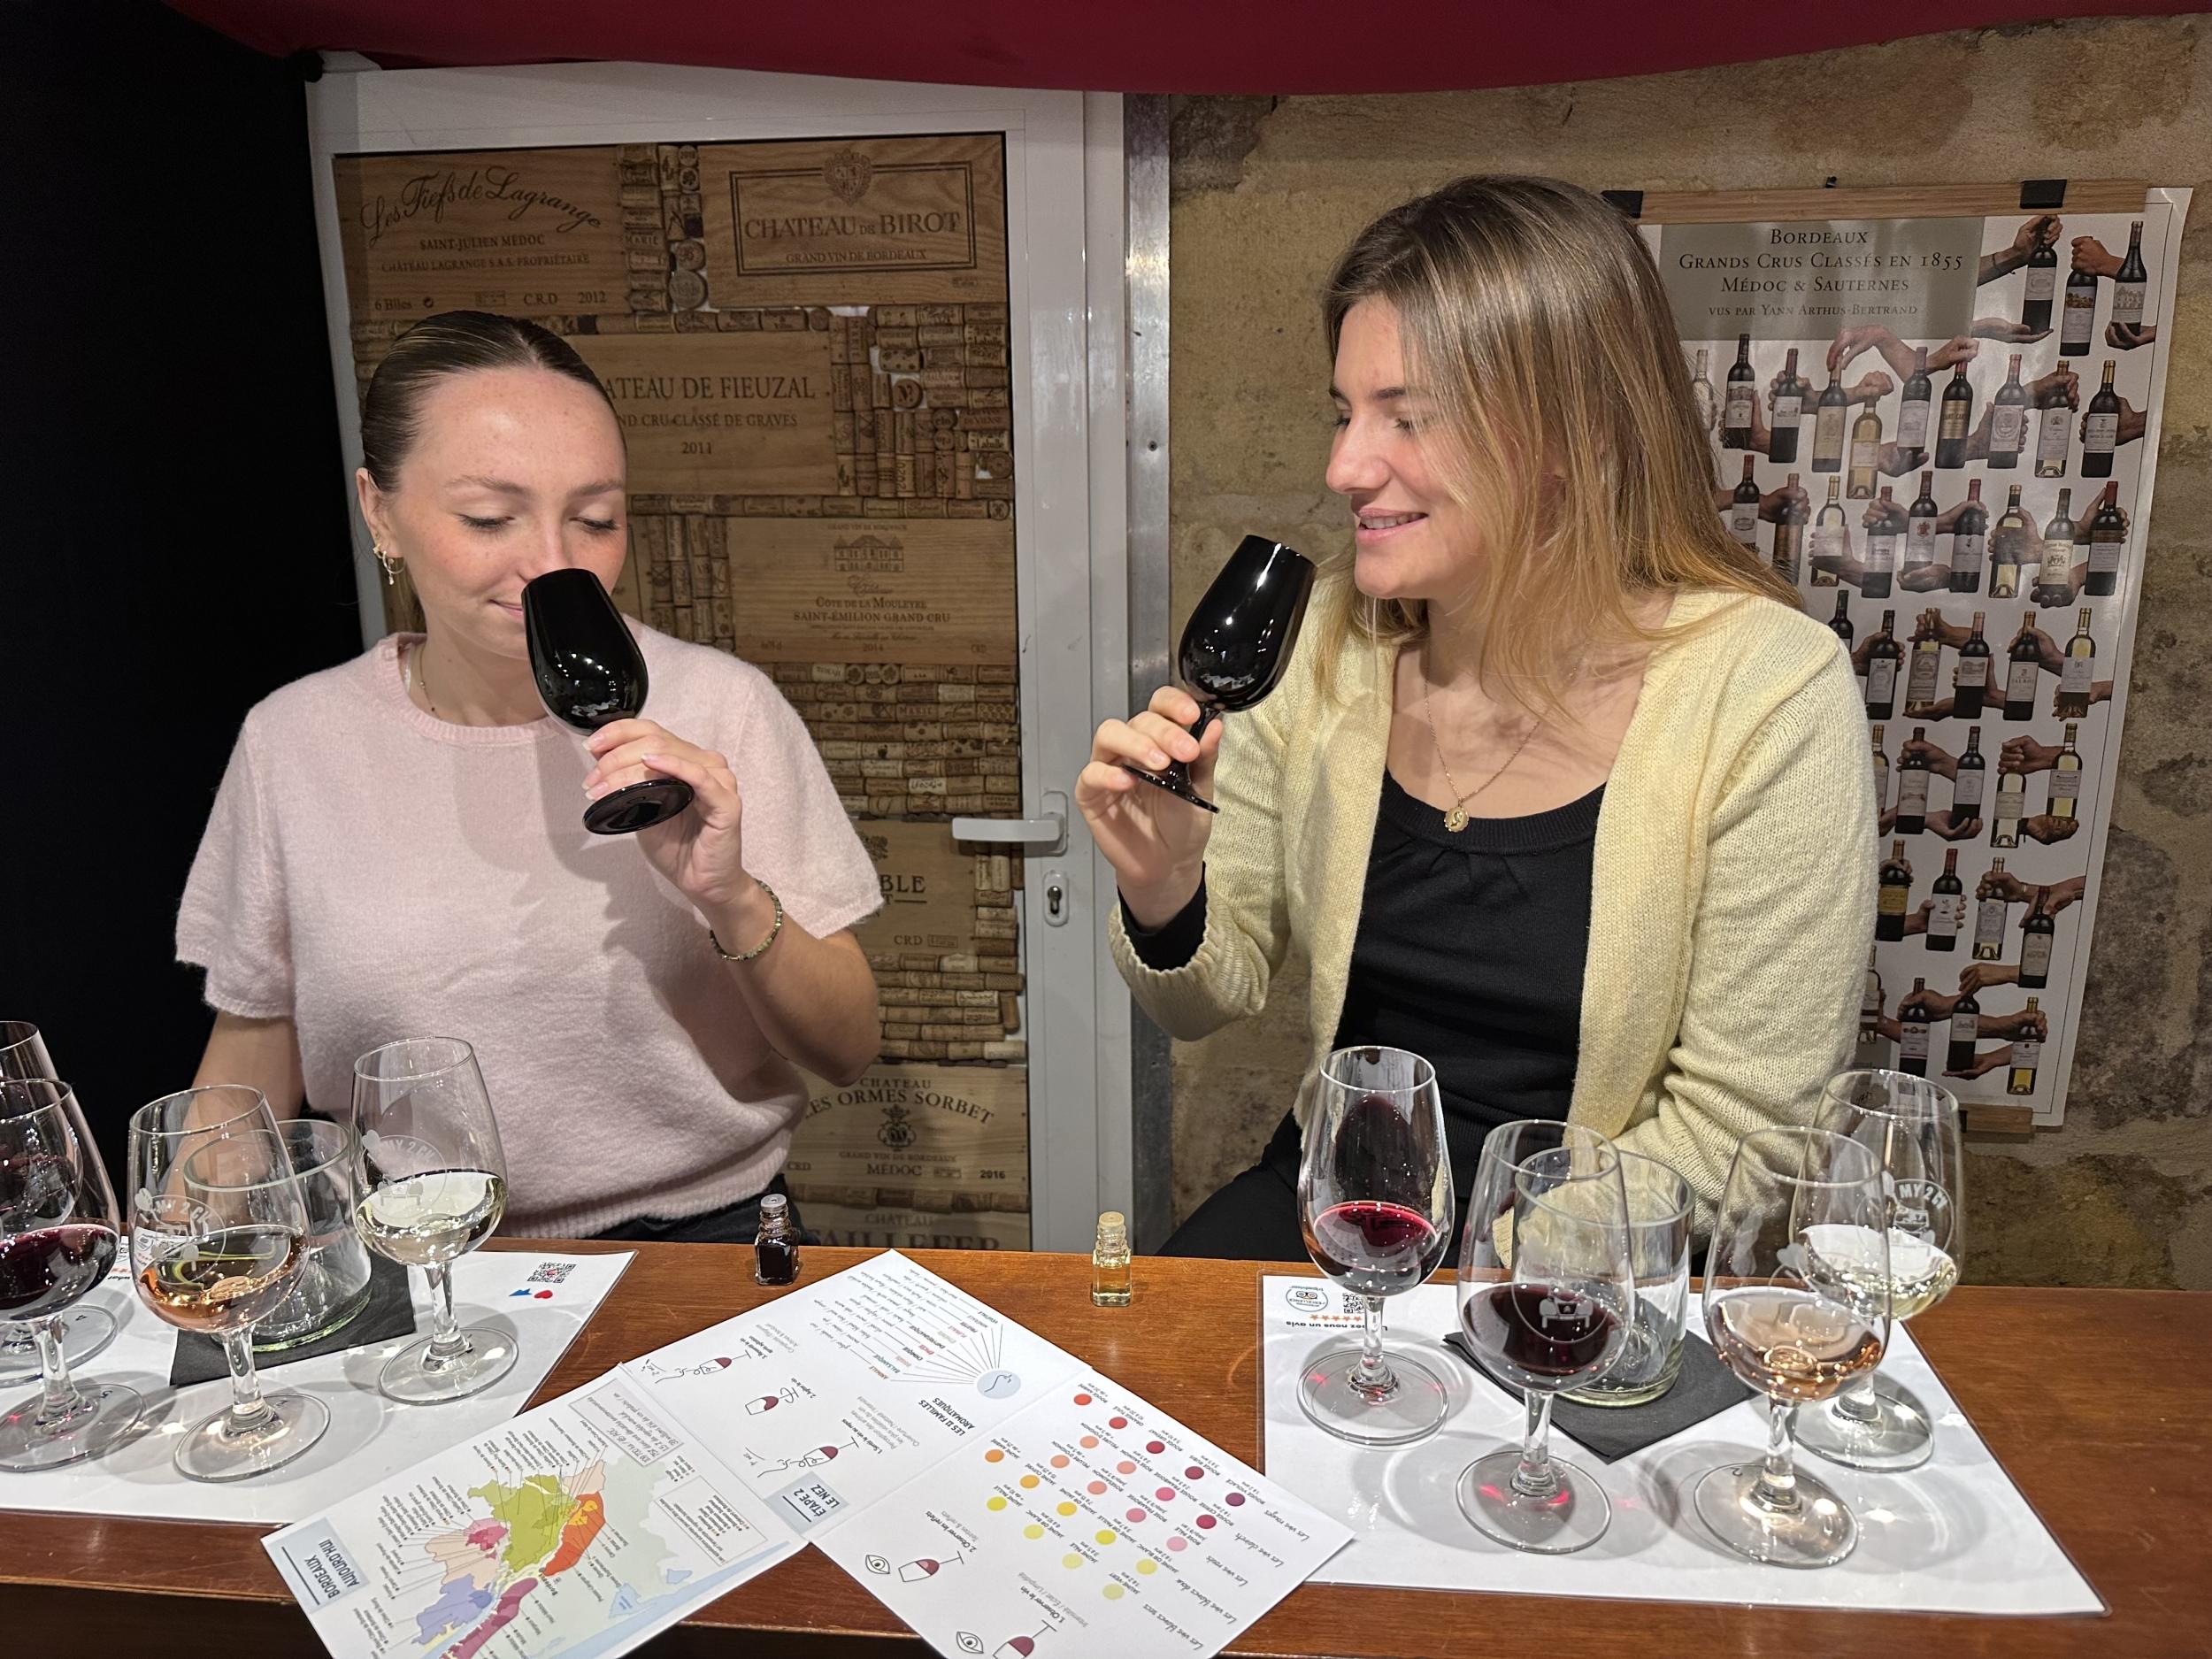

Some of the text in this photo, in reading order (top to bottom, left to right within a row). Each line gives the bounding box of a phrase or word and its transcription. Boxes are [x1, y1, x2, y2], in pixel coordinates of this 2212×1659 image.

[458, 171, 484, 200] de
[486, 166, 602, 234] Lagrange
[745, 211, 960, 240] CHATEAU DE BIROT
[419, 236, 498, 252] SAINT-JULIEN
[1770, 228, 1869, 244] BORDEAUX
[432, 258, 484, 271] LAGRANGE
[786, 248, 927, 265] GRAND VIN DE BORDEAUX
[1678, 253, 1749, 269] GRANDS
[1757, 253, 1802, 268] CRUS
[1810, 251, 1881, 268] CLASSÉS
[1920, 253, 1962, 272] 1855
[1721, 276, 1909, 293] MÉDOC & SAUTERNES
[577, 290, 608, 304] 2012
[1761, 304, 1793, 317] YANN
[1798, 303, 1918, 317] ARTHUS-BERTRAND
[604, 377, 816, 400] ATEAU DE FIEUZAL
[641, 414, 669, 427] CRU
[724, 414, 743, 427] DE
[747, 414, 798, 427] GRAVES
[795, 609, 950, 623] SAINT-ÉMILION GRAND CRU
[881, 875, 926, 894] BLE
[894, 934, 922, 946] CRD
[837, 1089, 907, 1106] ORMES
[914, 1090, 995, 1124] SORBET
[980, 1170, 1005, 1179] 2016
[1899, 1184, 1922, 1198] MY
[809, 1229, 1000, 1249] AILLEFER
[918, 1400, 948, 1422] FAMILLES
[933, 1397, 974, 1428] AROMATIQUES
[950, 1425, 965, 1435] LES
[810, 1484, 830, 1499] NEZ
[799, 1494, 826, 1516] ÉTAPE
[319, 1540, 358, 1586] AUJOURD'HUI
[305, 1555, 339, 1597] BORDEAUX
